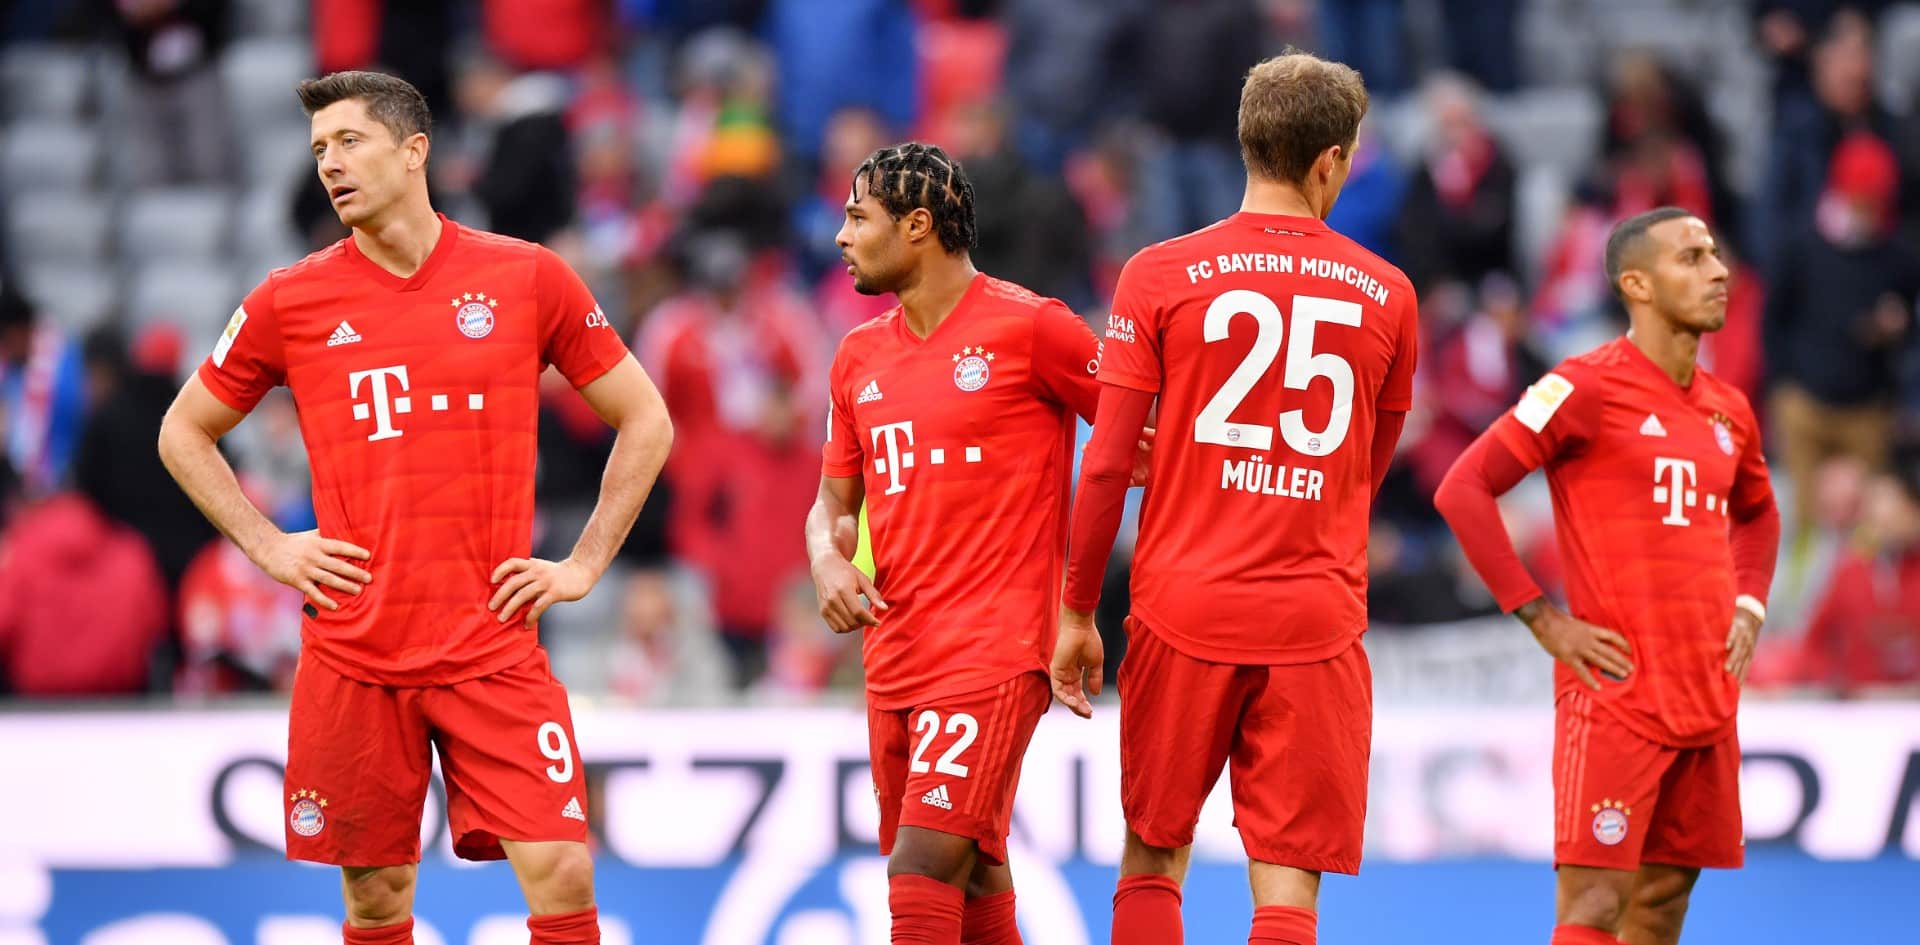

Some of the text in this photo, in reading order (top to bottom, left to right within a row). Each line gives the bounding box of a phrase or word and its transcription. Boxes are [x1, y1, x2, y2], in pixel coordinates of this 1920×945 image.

[1186, 253, 1390, 307] FC BAYERN MÜNCHEN
[327, 333, 362, 347] adidas
[1107, 313, 1136, 334] ATAR
[1194, 289, 1362, 457] 25
[1221, 454, 1324, 501] MÜLLER
[537, 721, 574, 784] 9
[911, 709, 979, 778] 22
[921, 795, 953, 810] adidas
